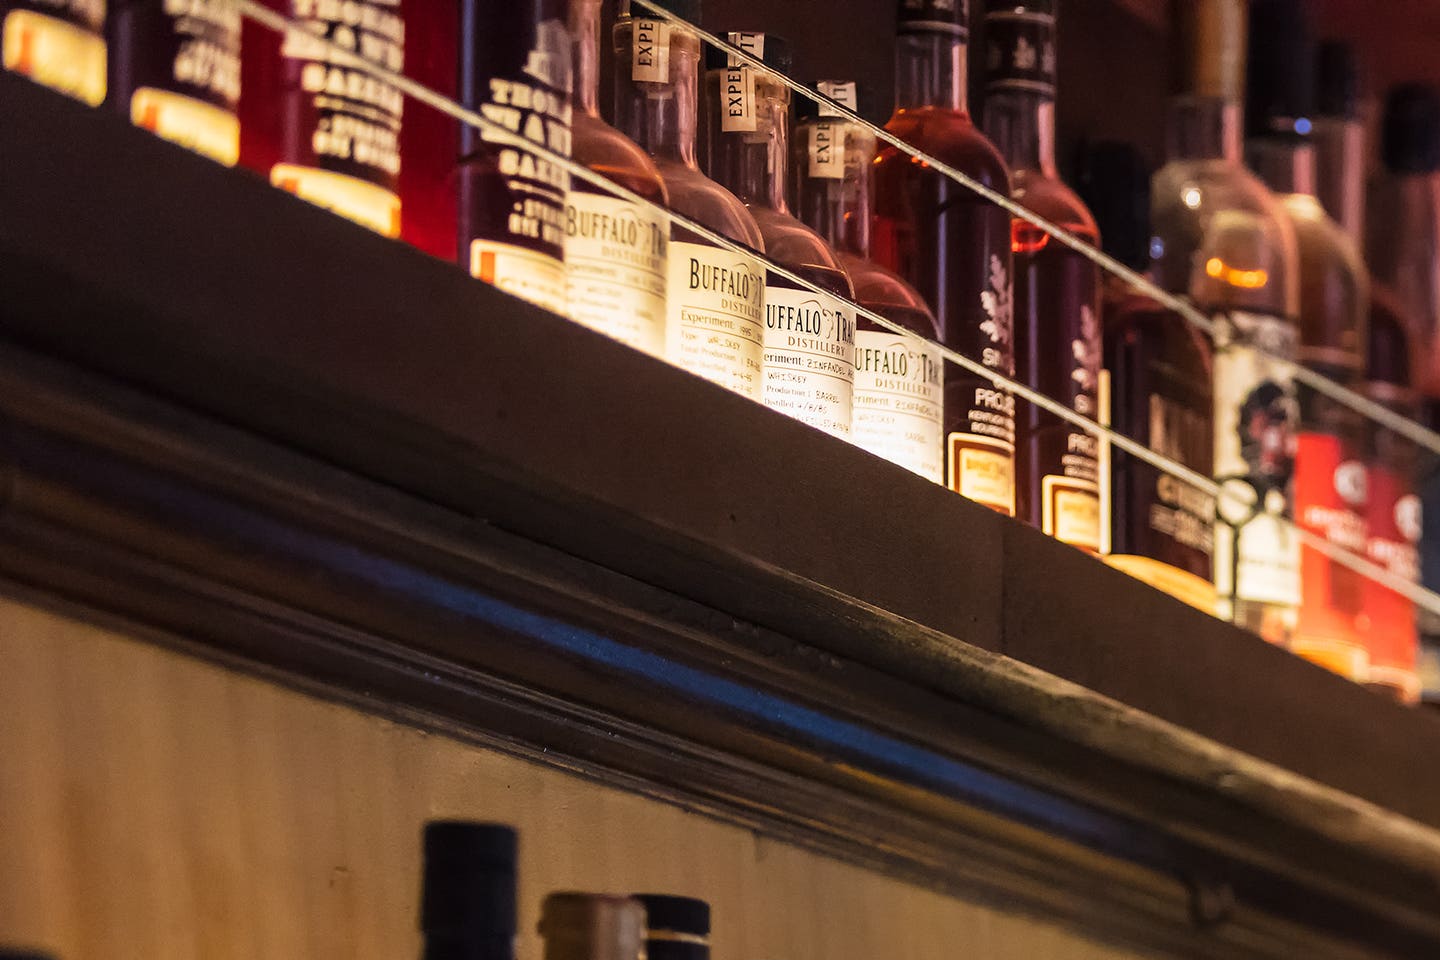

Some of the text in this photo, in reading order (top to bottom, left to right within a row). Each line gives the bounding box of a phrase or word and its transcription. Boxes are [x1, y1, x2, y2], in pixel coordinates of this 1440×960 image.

[566, 205, 638, 246] BUFFALO
[689, 258, 749, 299] BUFFALO
[766, 304, 821, 335] UFFALO
[764, 353, 804, 366] eriment:
[788, 336, 846, 357] DISTILLERY
[855, 347, 908, 377] UFFALO
